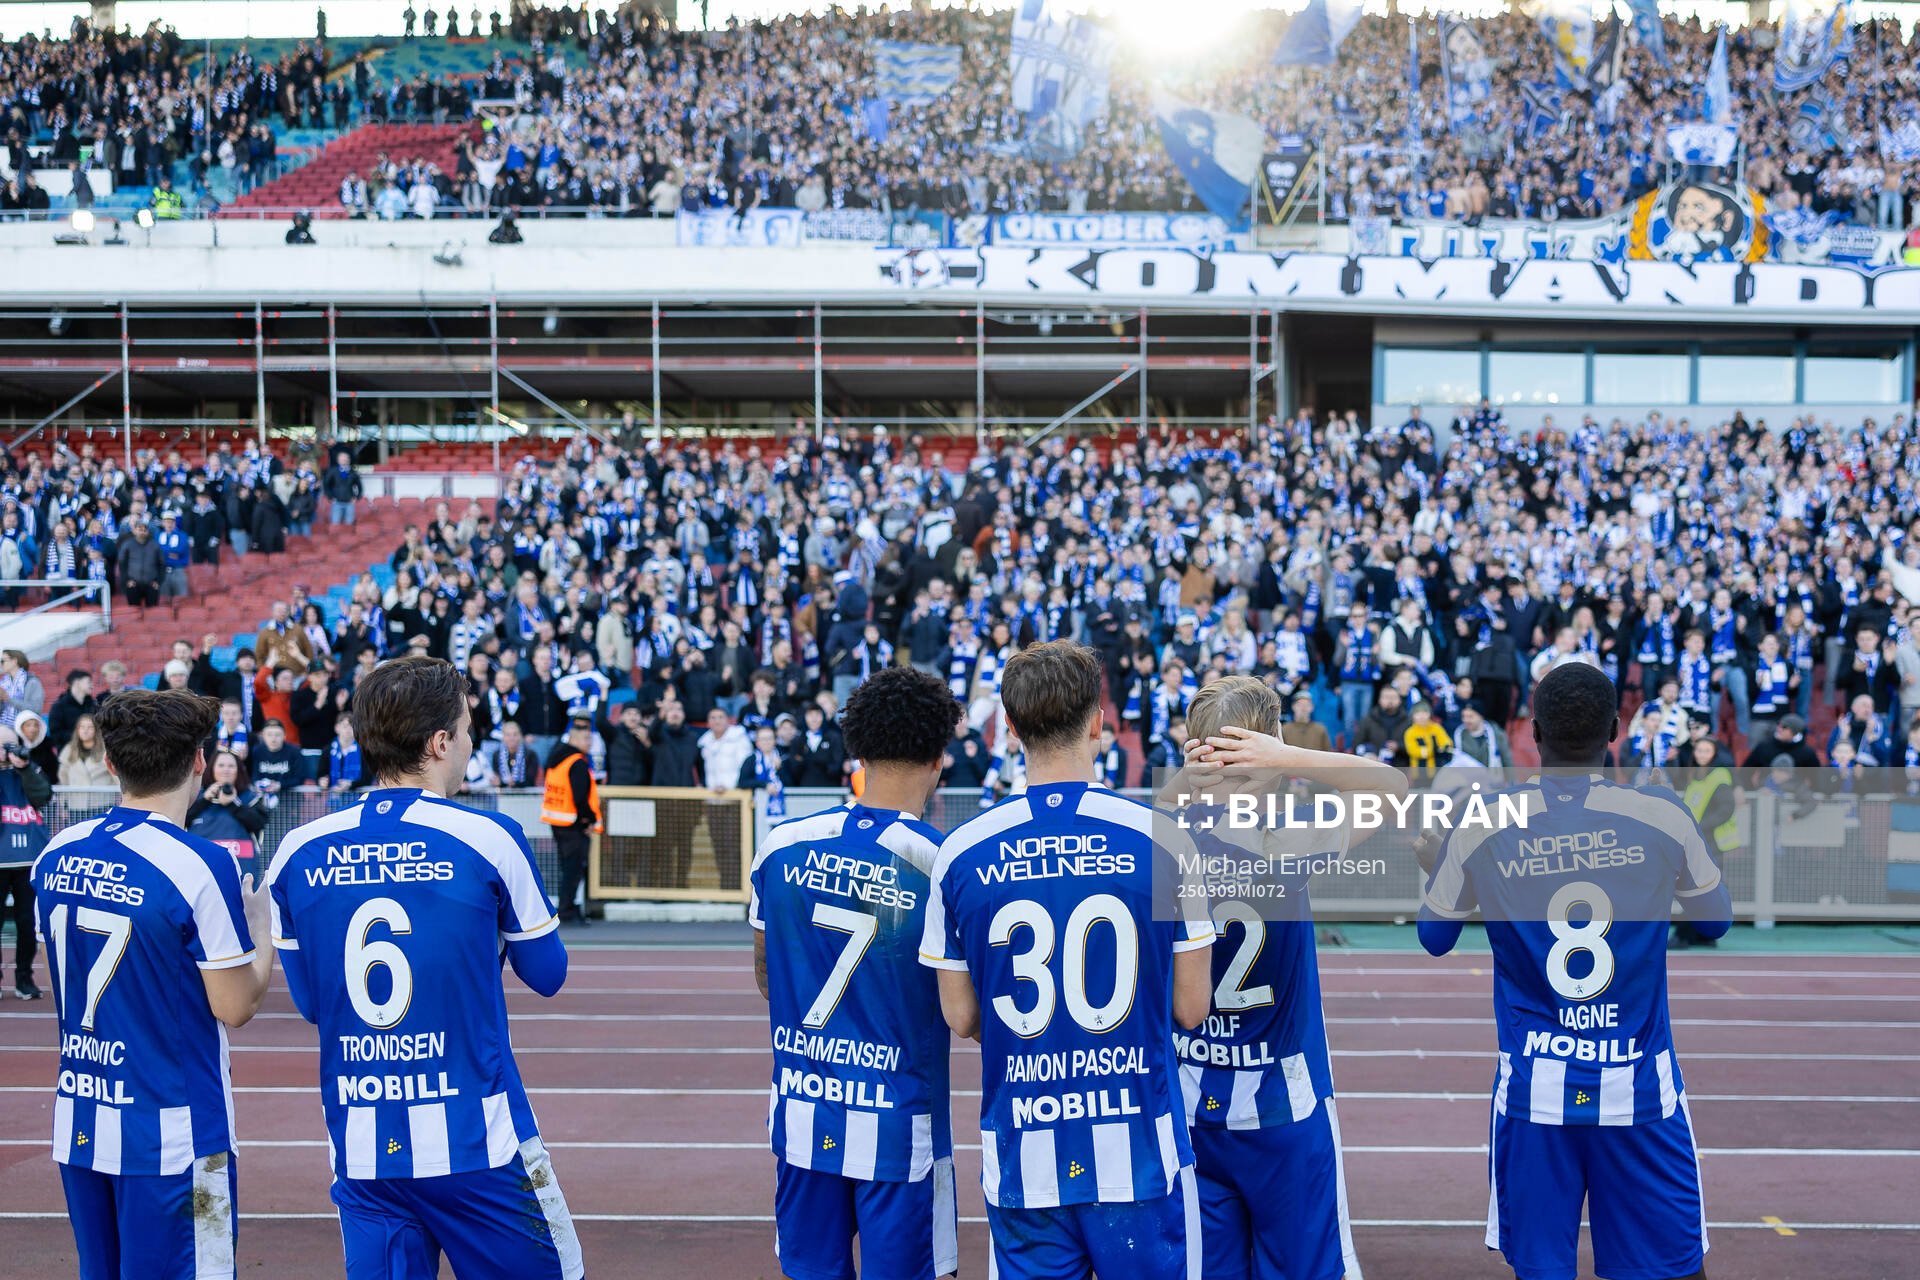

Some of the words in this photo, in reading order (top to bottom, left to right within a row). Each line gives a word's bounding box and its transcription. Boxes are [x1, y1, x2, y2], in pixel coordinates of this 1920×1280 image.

[1004, 215, 1168, 241] OKTOBER
[2, 805, 37, 823] HOTO
[327, 842, 427, 865] NORDIC
[1000, 834, 1107, 861] NORDIC
[1518, 829, 1617, 856] NORDIC
[56, 855, 128, 882] NORDIC
[304, 861, 454, 887] WELLNESS
[805, 849, 897, 885] NORDIC
[976, 855, 1135, 886] WELLNESS
[1497, 846, 1645, 878] WELLNESS
[43, 872, 145, 906] WELLNESS
[783, 864, 916, 910] WELLNESS
[1212, 900, 1274, 1011] 2
[1546, 881, 1615, 1001] 8
[49, 903, 133, 1032] 17
[344, 898, 412, 1029] 6
[802, 902, 878, 1029] 7
[988, 894, 1139, 1039] 30
[61, 1029, 126, 1066] ARKOVIC
[339, 1031, 445, 1062] TRONDSEN
[774, 1025, 900, 1072] CLEMMENSEN
[1172, 1032, 1275, 1067] MOBILL
[1523, 1031, 1643, 1062] MOBILL
[1006, 1051, 1067, 1083] RAMON
[1072, 1046, 1150, 1078] PASCAL
[57, 1069, 134, 1105] OBILL
[336, 1072, 459, 1105] MOBILL
[780, 1067, 893, 1109] MOBILL
[1012, 1088, 1141, 1128] MOBILL
